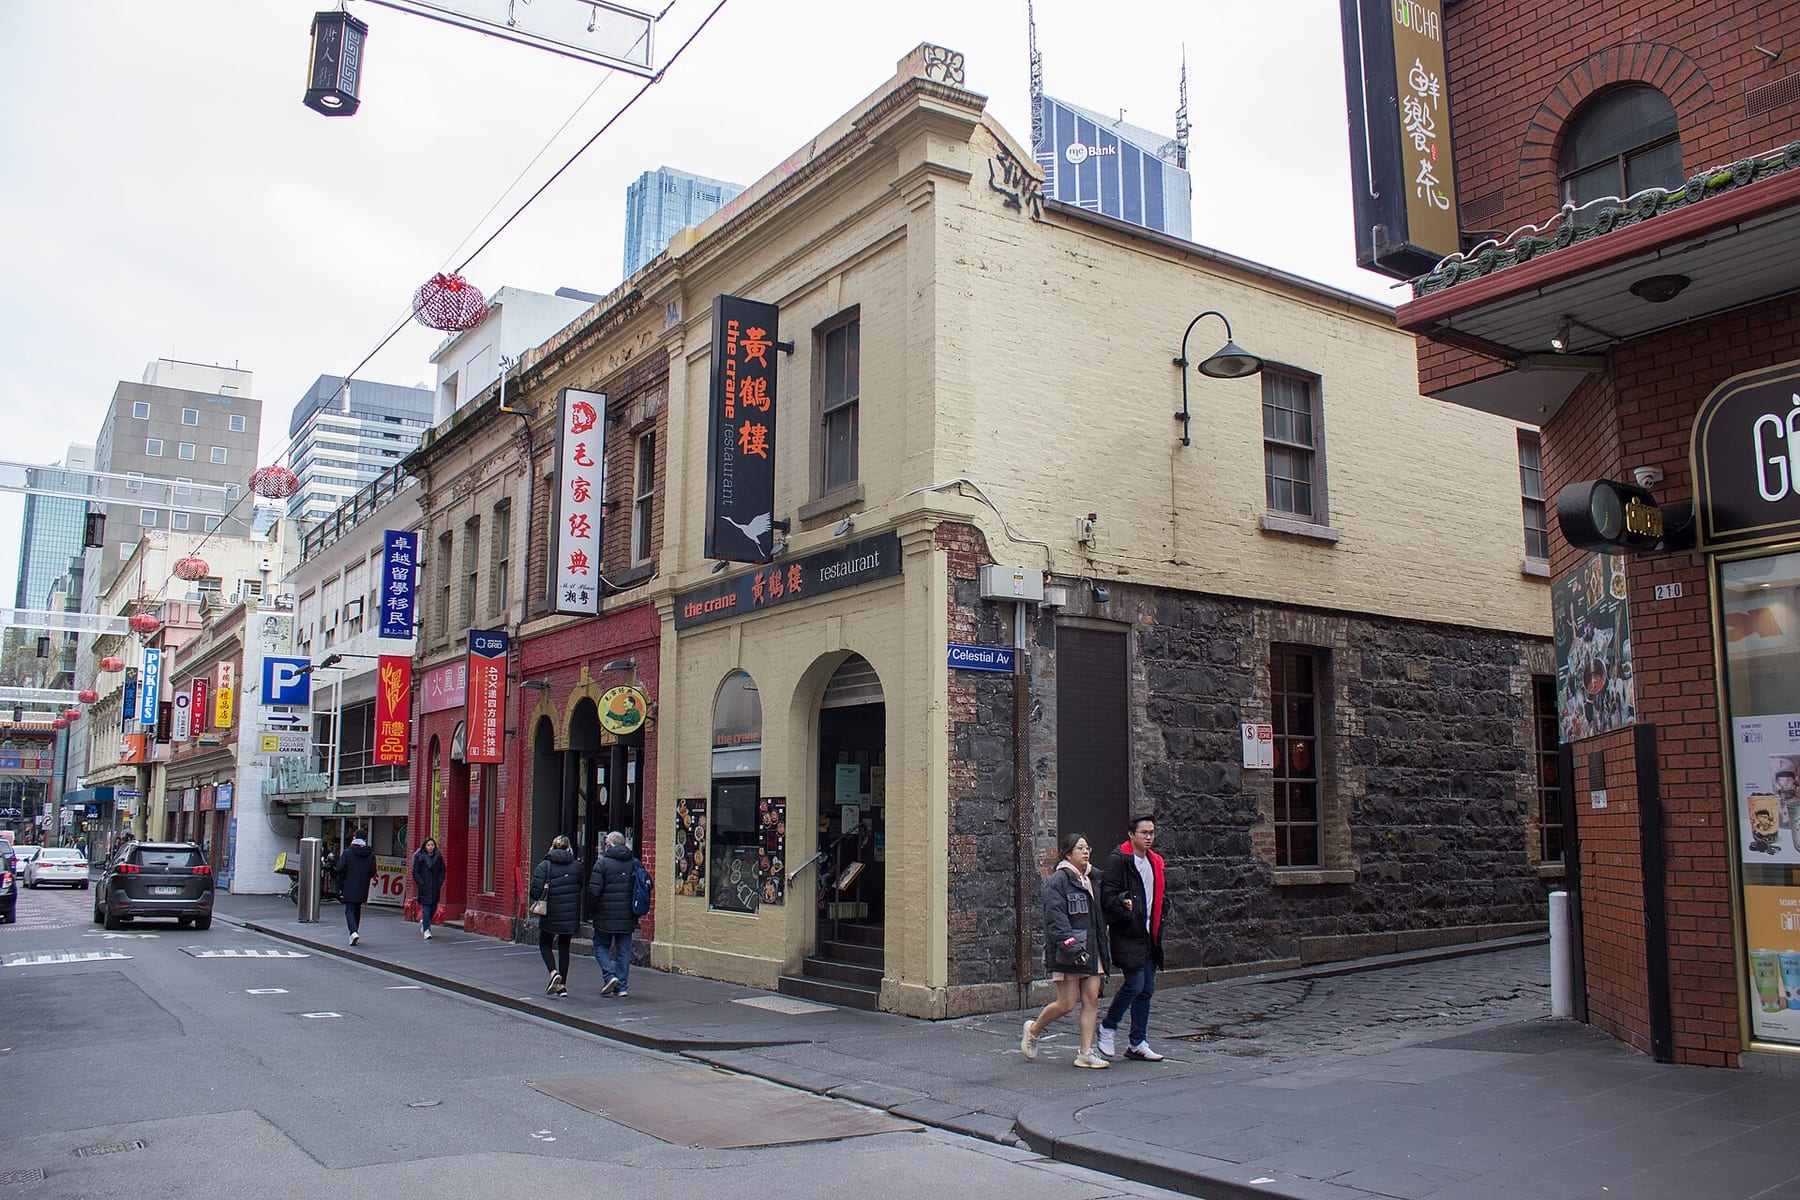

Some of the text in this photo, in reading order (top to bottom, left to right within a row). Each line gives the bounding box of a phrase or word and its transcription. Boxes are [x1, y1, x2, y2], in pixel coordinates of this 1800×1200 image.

[1088, 145, 1116, 156] Bank
[722, 319, 740, 505] the crane restaurant
[566, 441, 596, 576] 毛家经典
[819, 550, 880, 582] restaurant
[387, 536, 412, 626] 卓越留學移民
[1656, 584, 1681, 599] 210
[683, 592, 737, 619] the crane
[952, 647, 1010, 664] Celestial Av
[144, 652, 158, 719] POKIES
[193, 712, 202, 734] WING
[716, 730, 759, 745] the crane
